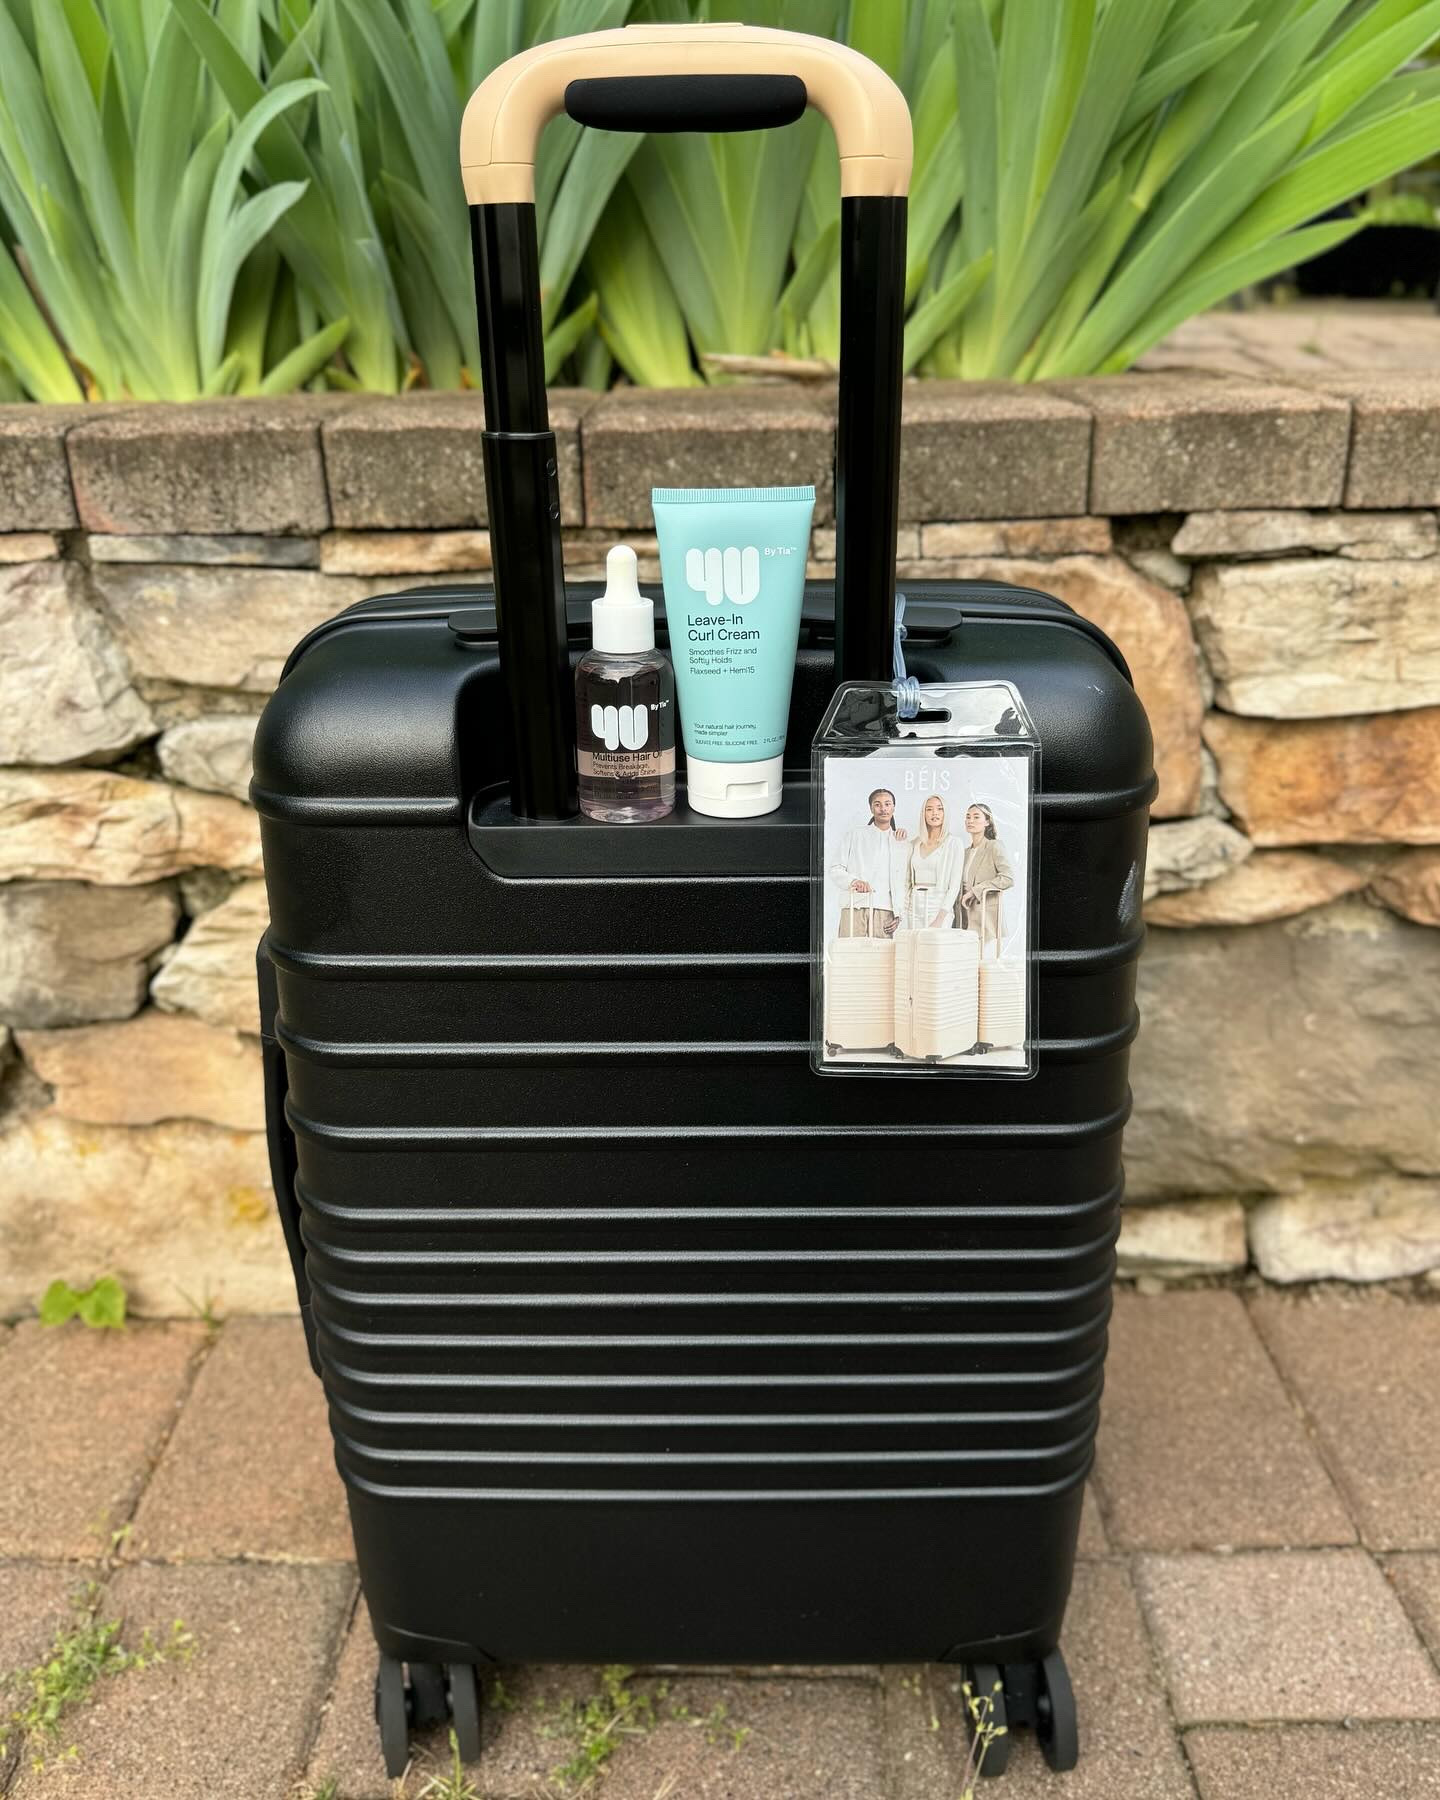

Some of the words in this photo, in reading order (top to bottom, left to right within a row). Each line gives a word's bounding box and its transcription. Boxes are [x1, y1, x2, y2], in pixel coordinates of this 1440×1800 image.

[764, 547, 776, 557] By
[687, 613, 743, 627] Leave-In
[688, 629, 714, 642] Curl
[717, 628, 760, 641] Cream
[688, 648, 725, 656] Smoothes
[726, 647, 742, 655] Frizz
[743, 647, 758, 655] and
[689, 656, 710, 666] Softly
[711, 656, 733, 664] Holds
[690, 667, 721, 675] Flaxseed
[650, 703, 659, 711] By
[735, 723, 757, 731] journey
[592, 752, 631, 763] Multiuse
[632, 753, 651, 762] Hair
[904, 765, 951, 791] BÉIS
